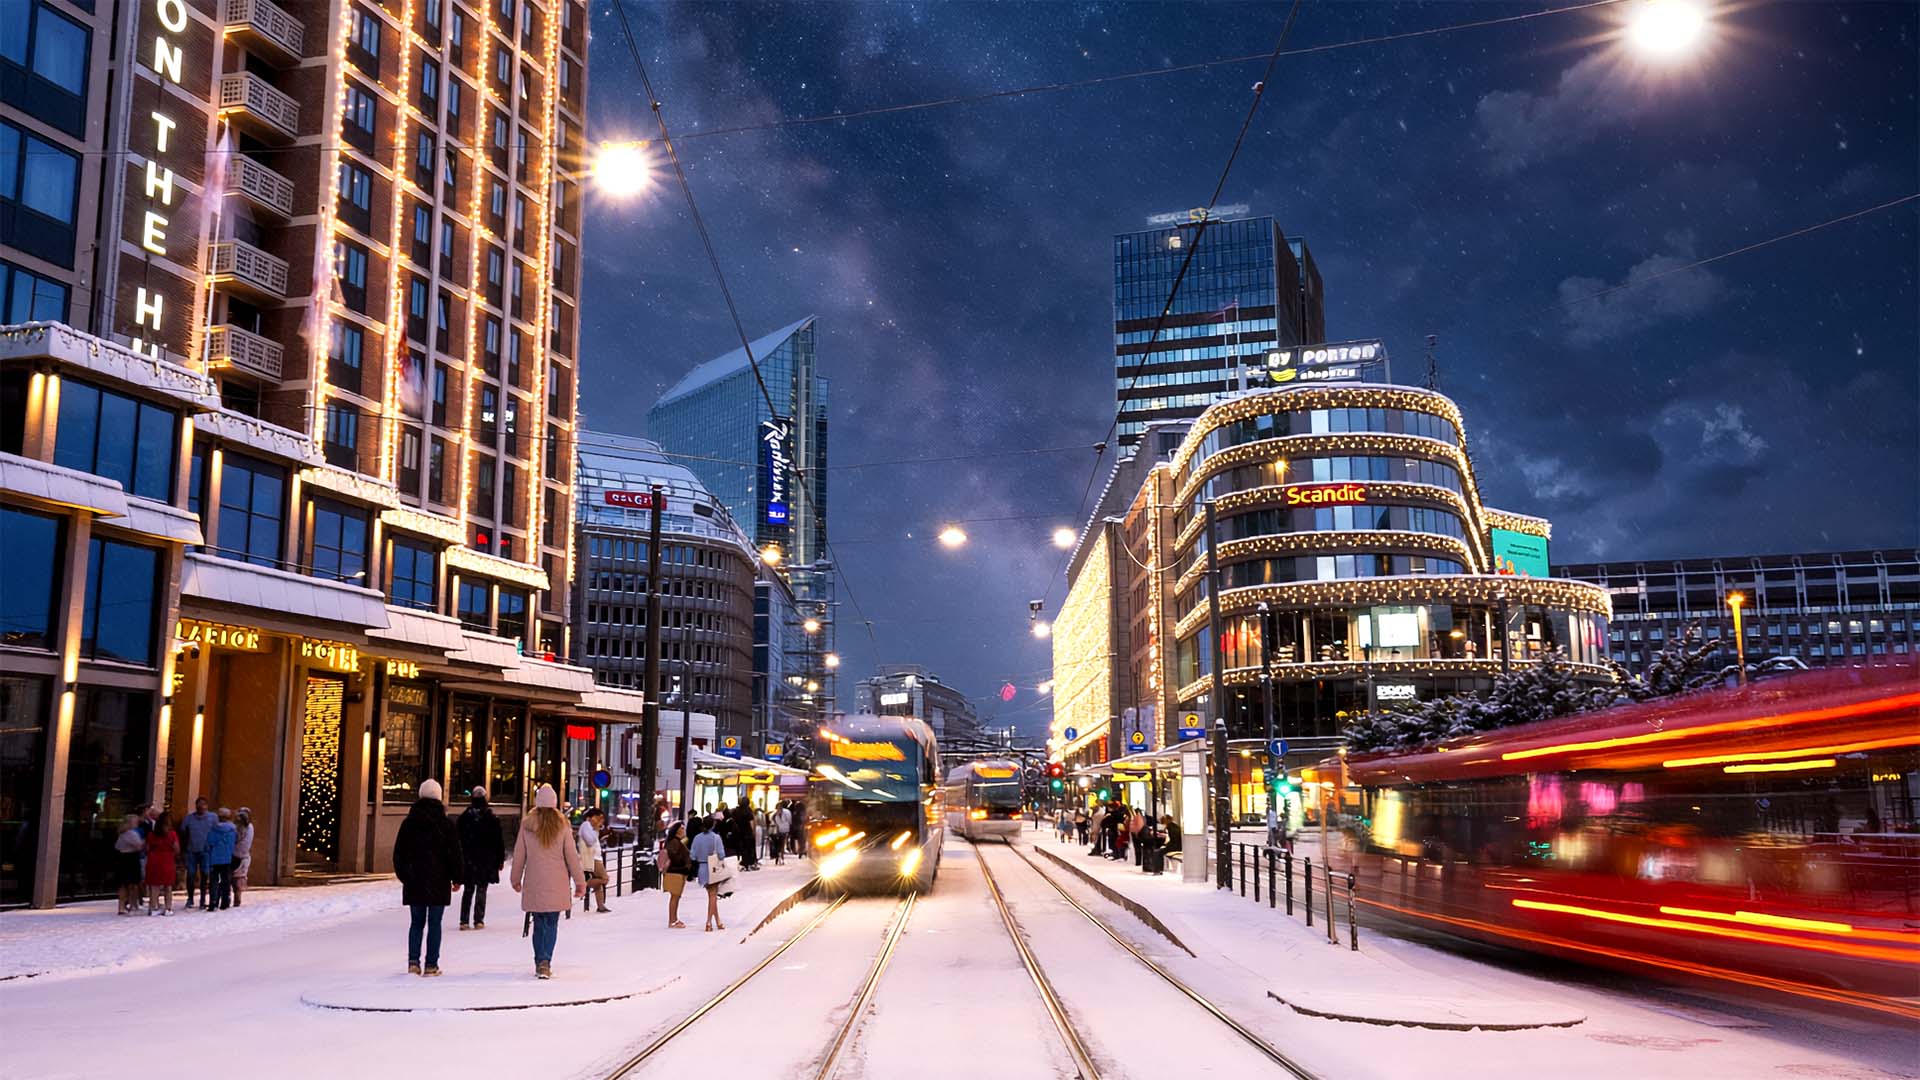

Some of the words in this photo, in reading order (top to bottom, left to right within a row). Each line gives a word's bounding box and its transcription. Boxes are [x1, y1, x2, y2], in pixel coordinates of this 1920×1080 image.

[154, 0, 187, 84] ON
[143, 111, 176, 255] THE
[1286, 484, 1366, 505] Scandic
